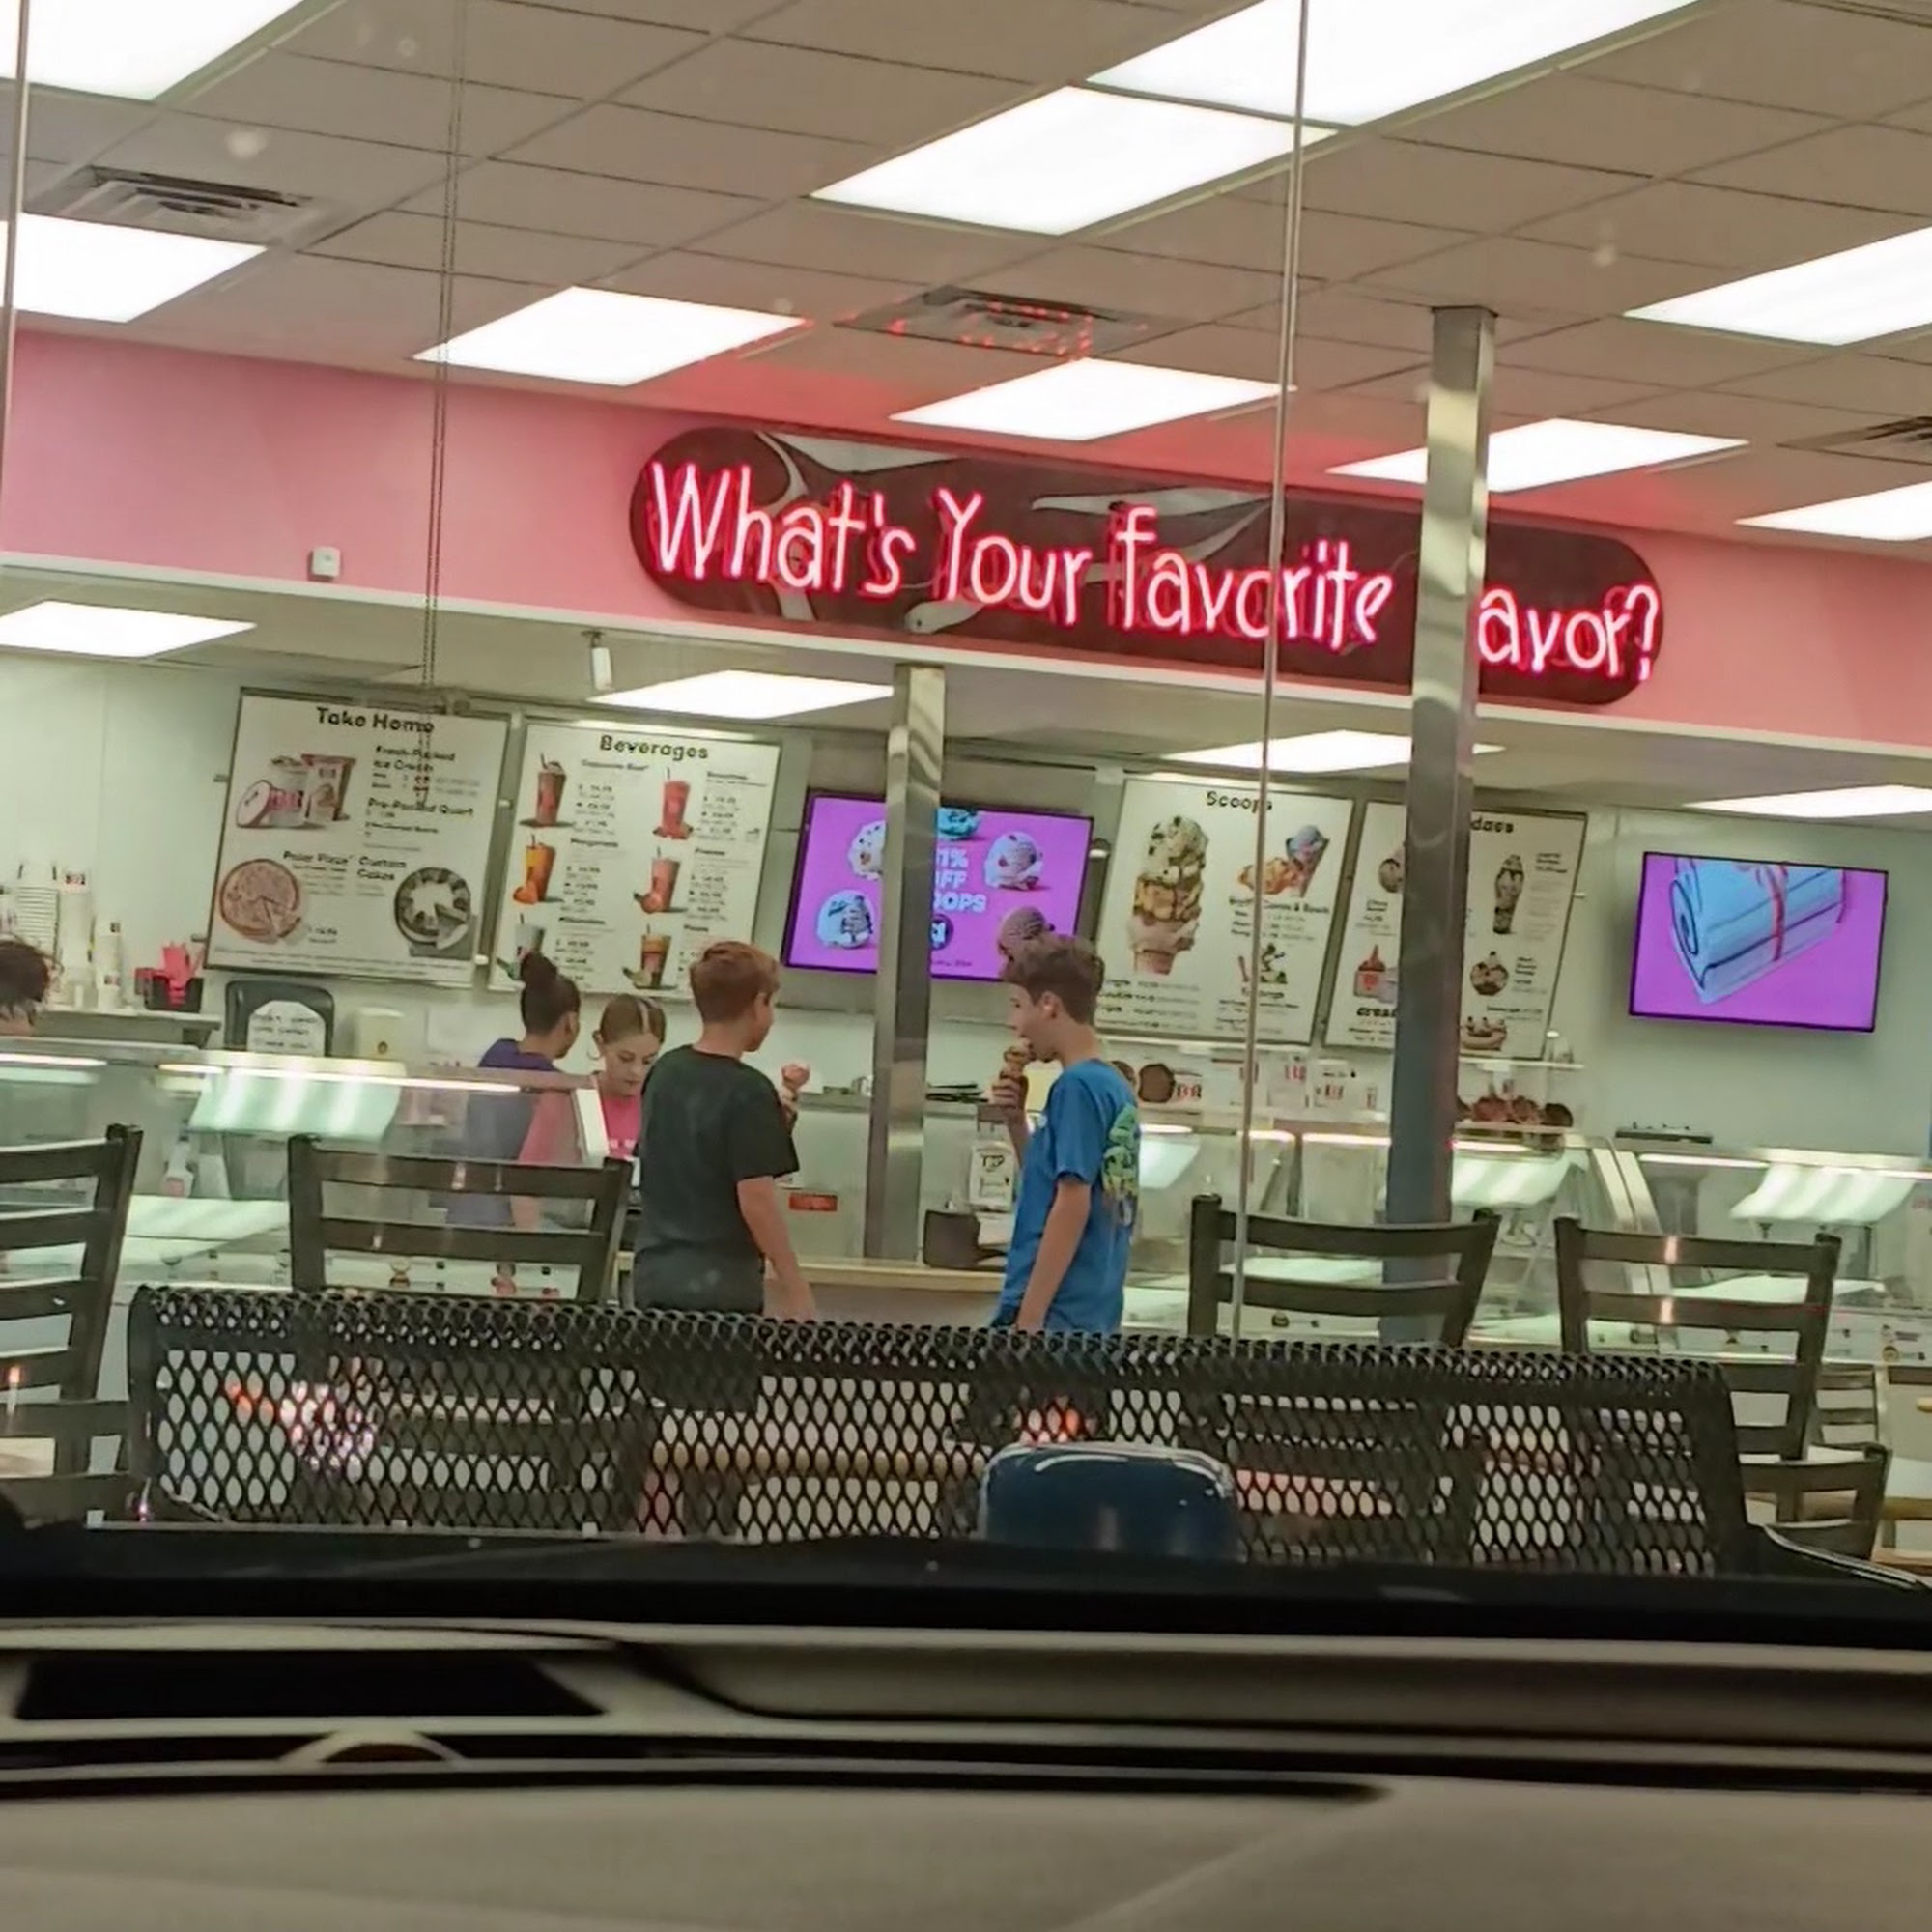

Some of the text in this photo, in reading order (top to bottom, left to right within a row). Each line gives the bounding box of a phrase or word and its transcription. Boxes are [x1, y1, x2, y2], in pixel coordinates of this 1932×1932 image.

[649, 460, 1661, 681] What's Your favorite avor?
[316, 705, 435, 733] Take Home
[600, 734, 709, 762] Beverages
[1469, 815, 1514, 834] daes
